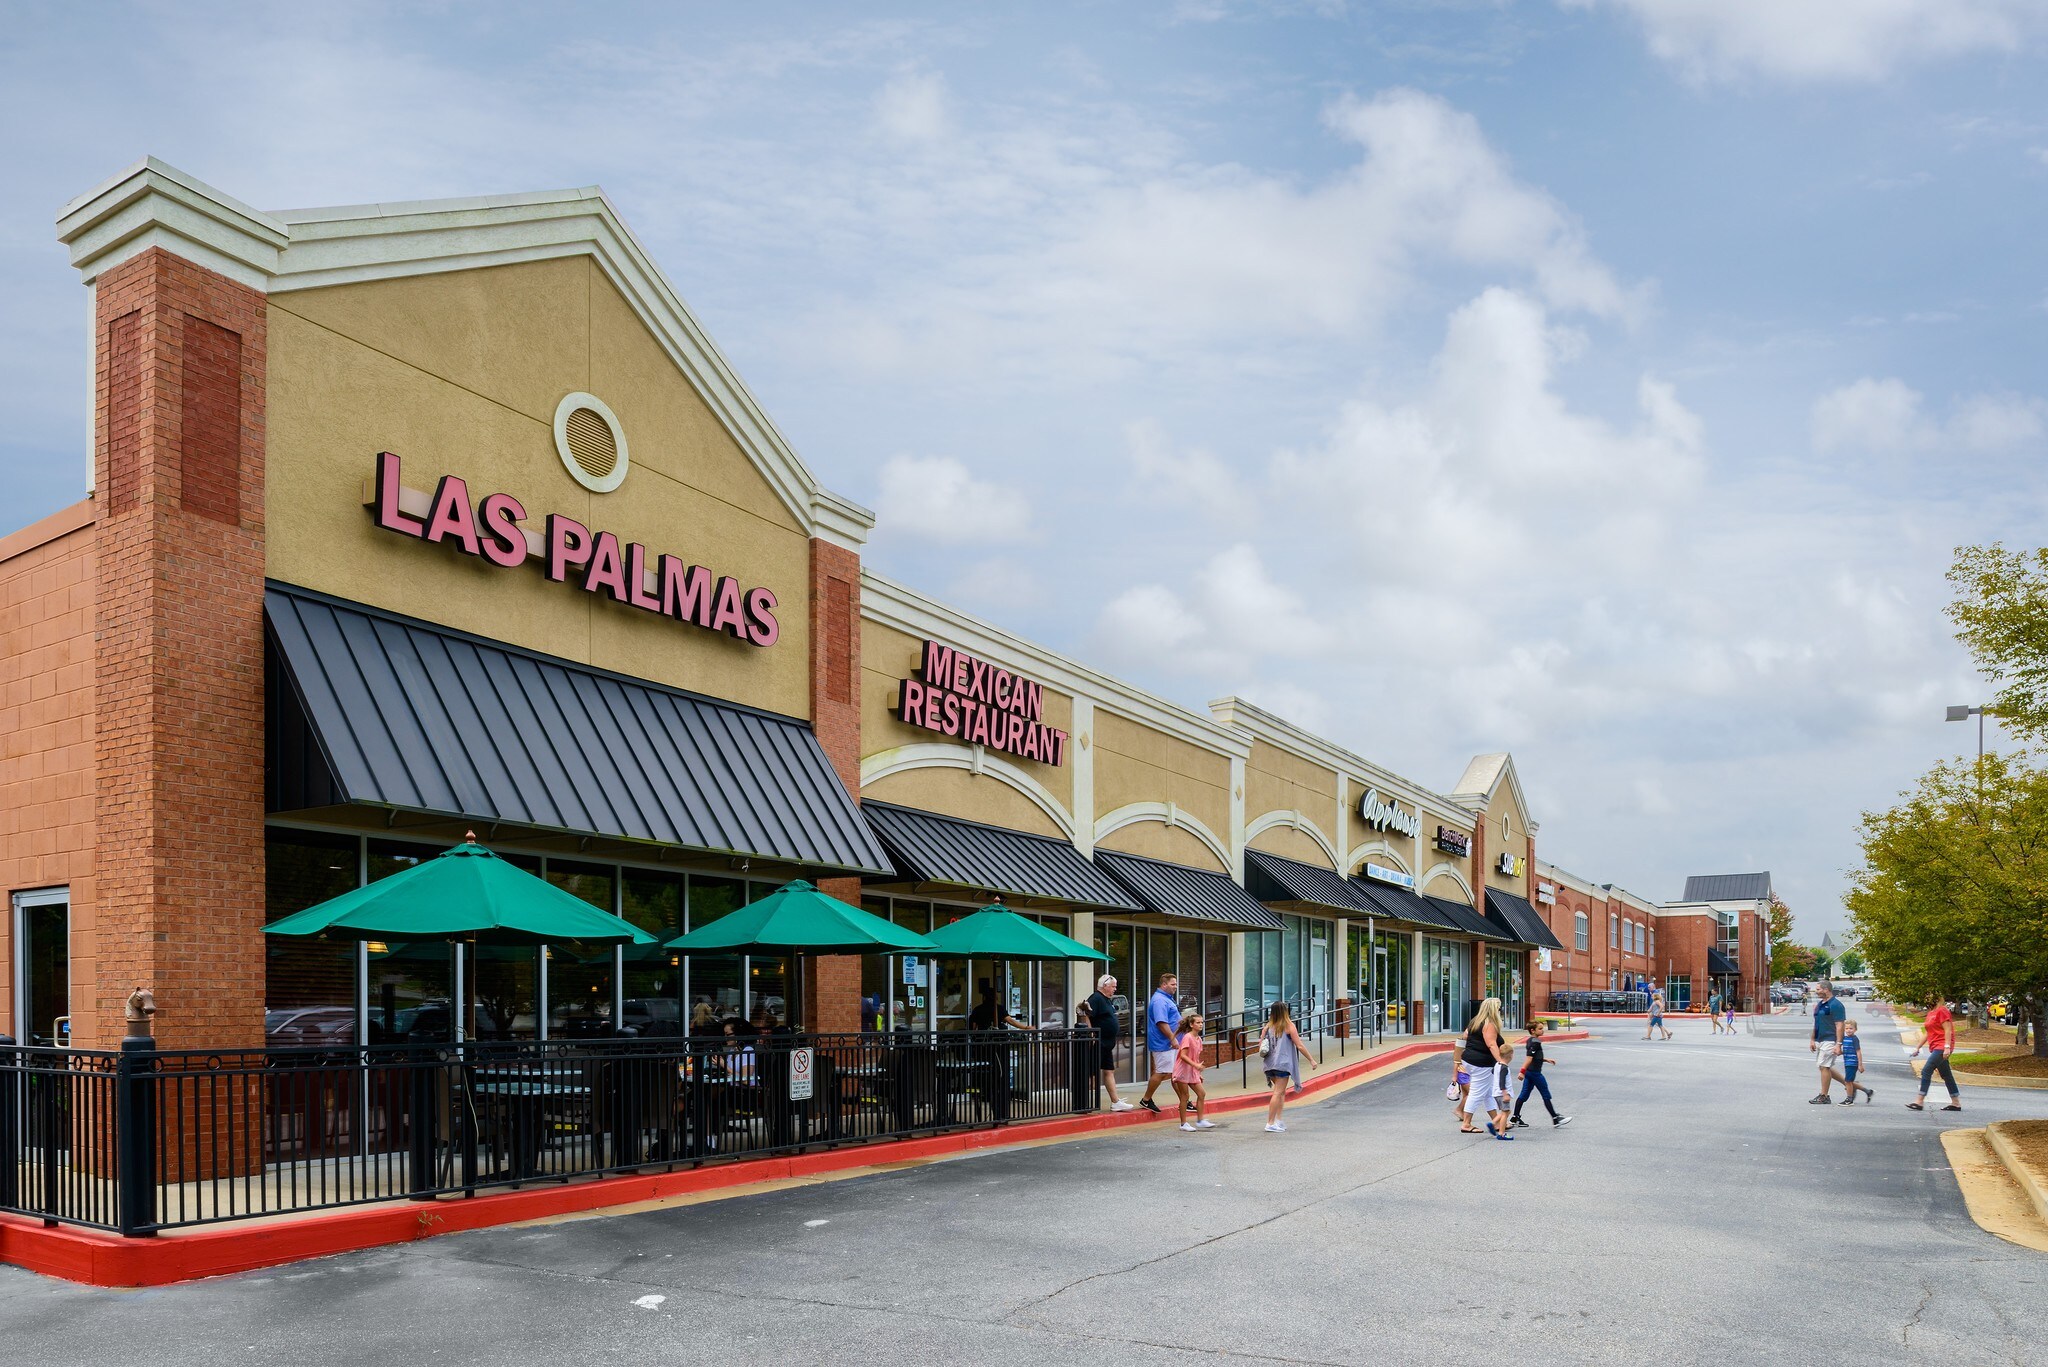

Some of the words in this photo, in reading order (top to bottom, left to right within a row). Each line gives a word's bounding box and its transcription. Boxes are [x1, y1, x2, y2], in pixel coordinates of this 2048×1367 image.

[375, 452, 528, 568] LAS
[546, 513, 780, 648] PALMAS
[899, 679, 1068, 767] RESTAURANT
[923, 640, 1043, 722] MEXICAN
[1502, 853, 1525, 878] SUBWAY
